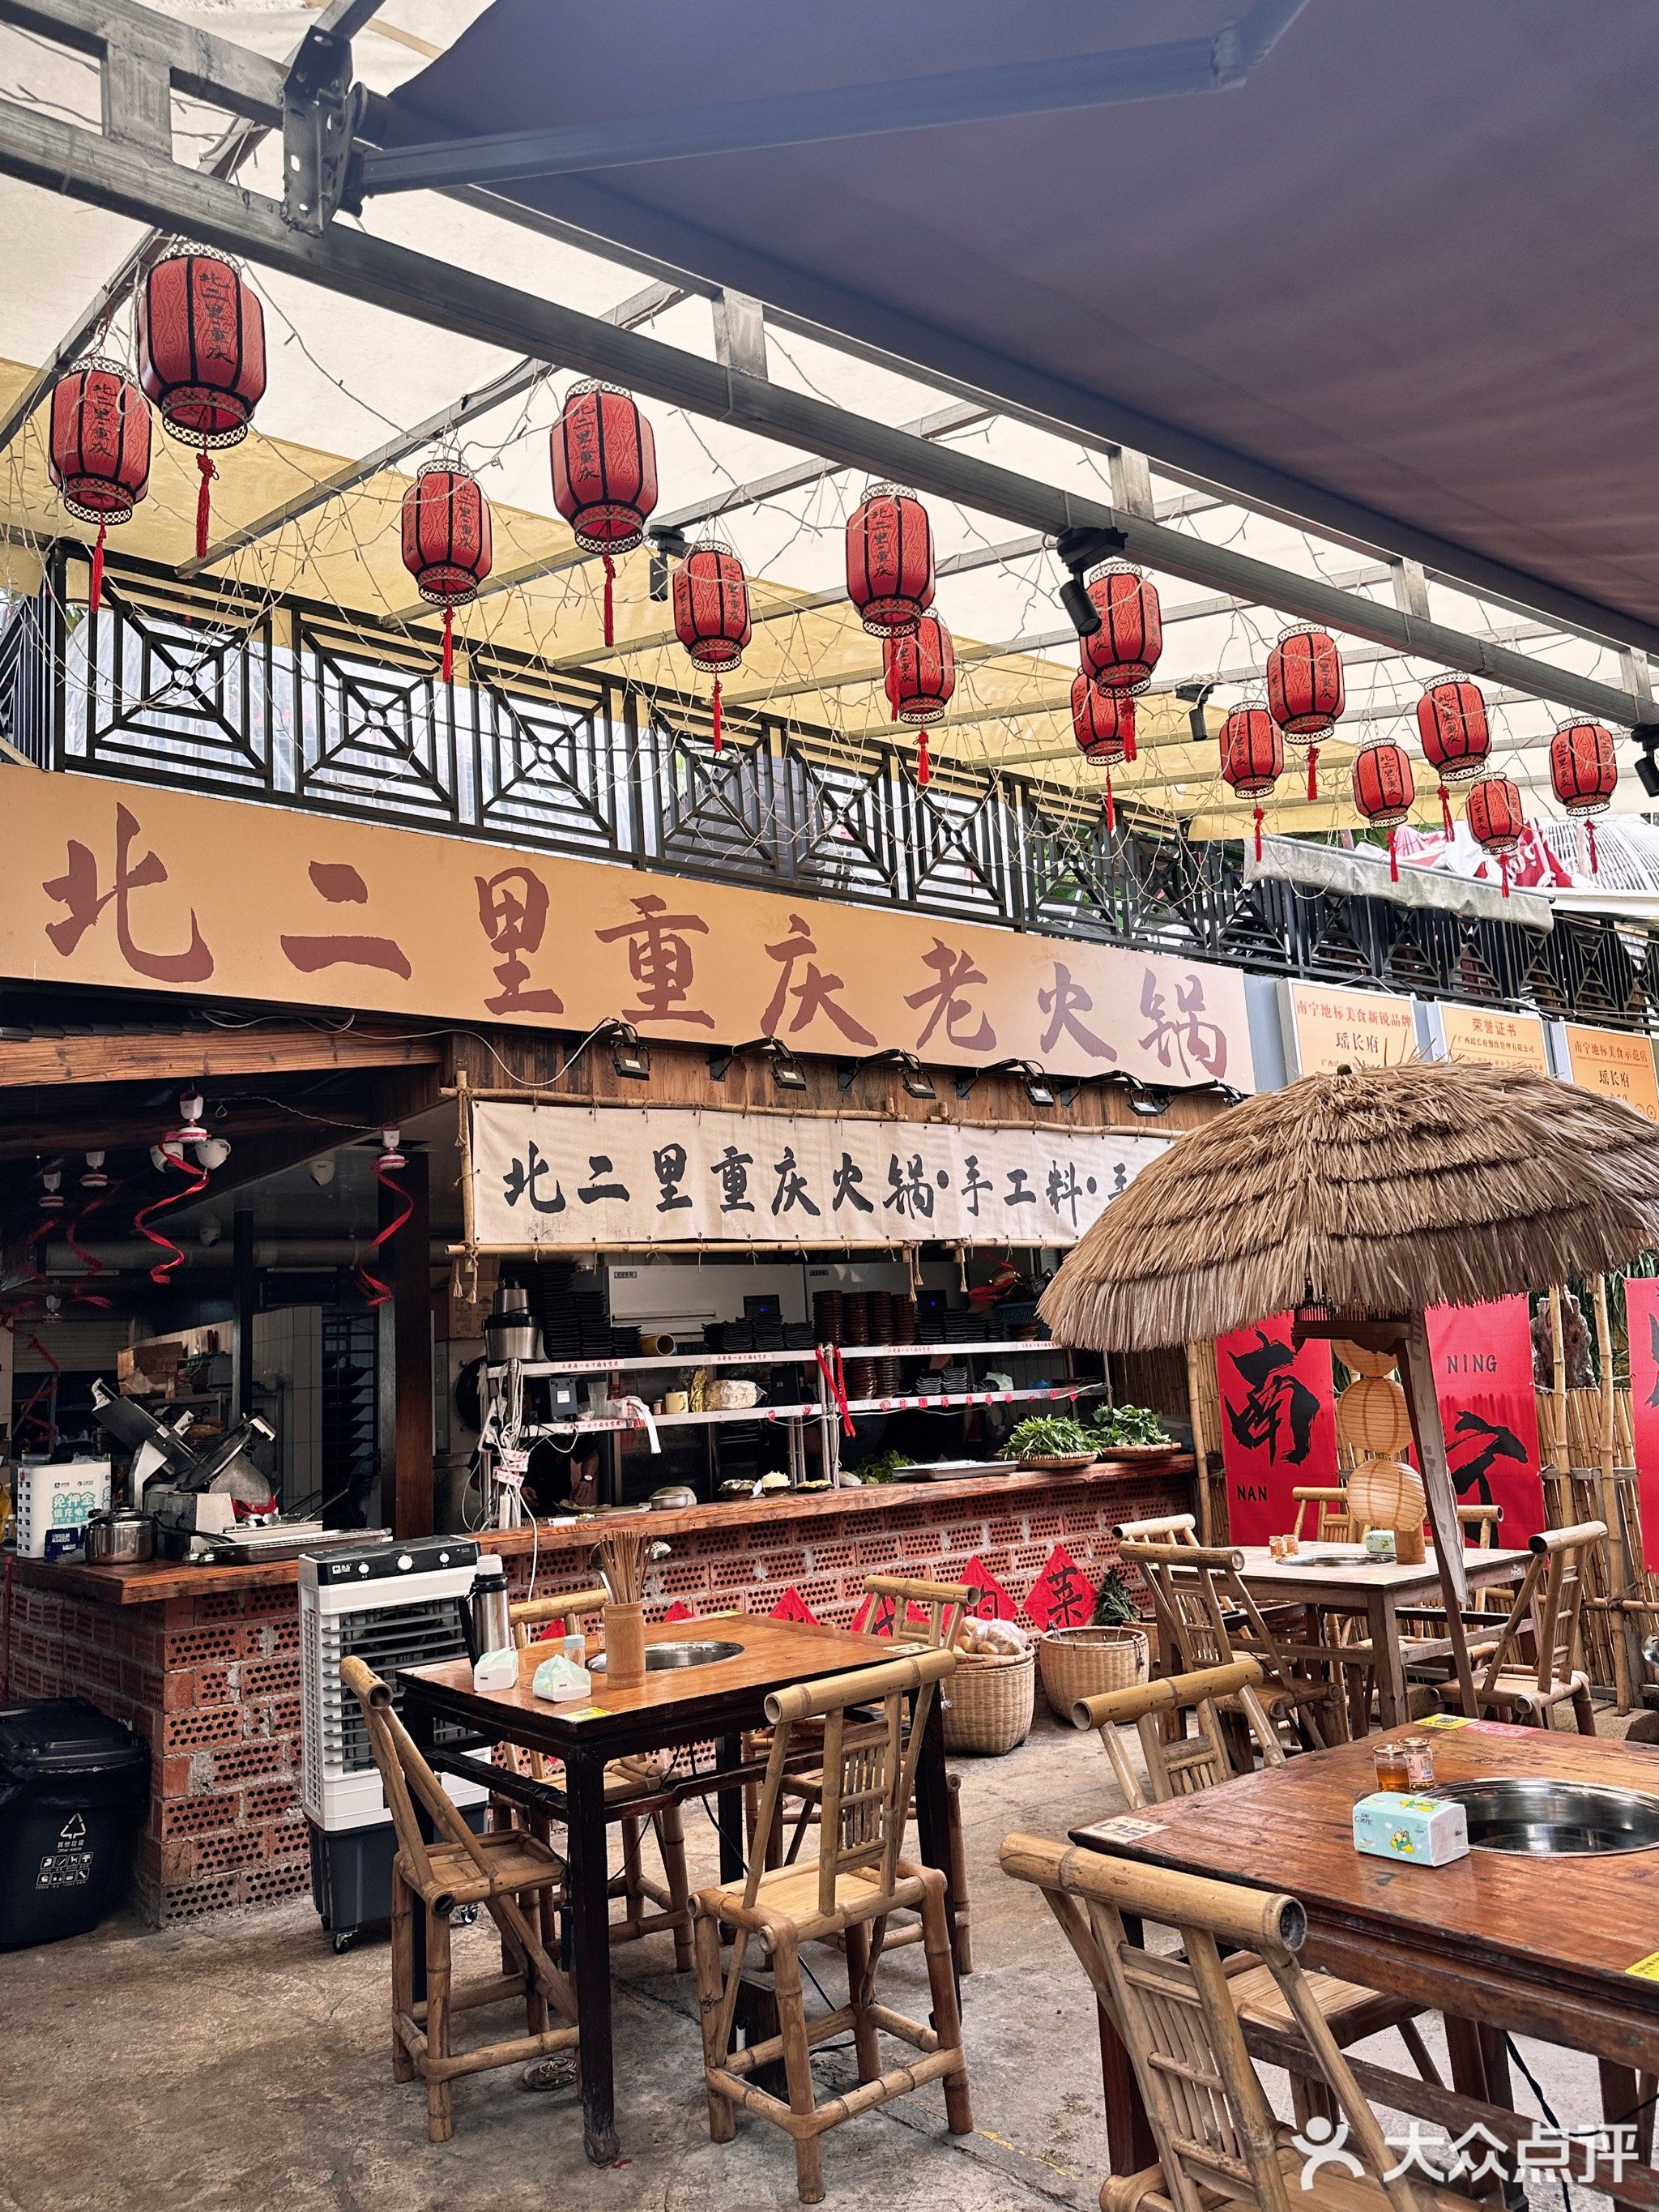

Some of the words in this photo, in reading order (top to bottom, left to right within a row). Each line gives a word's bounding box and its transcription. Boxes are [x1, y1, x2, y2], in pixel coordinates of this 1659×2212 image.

[42, 801, 1226, 1079] 北二里重庆老火锅
[1297, 1000, 1413, 1029] 南宁地标美食新锐品牌
[1472, 1017, 1516, 1037] 荣誉证书
[1574, 1040, 1648, 1063] 南宁地标美食示范店
[1447, 1354, 1498, 1373] NING
[1224, 1330, 1320, 1466] 南
[1236, 1484, 1268, 1502] NAN
[1047, 1564, 1082, 1629] 菜
